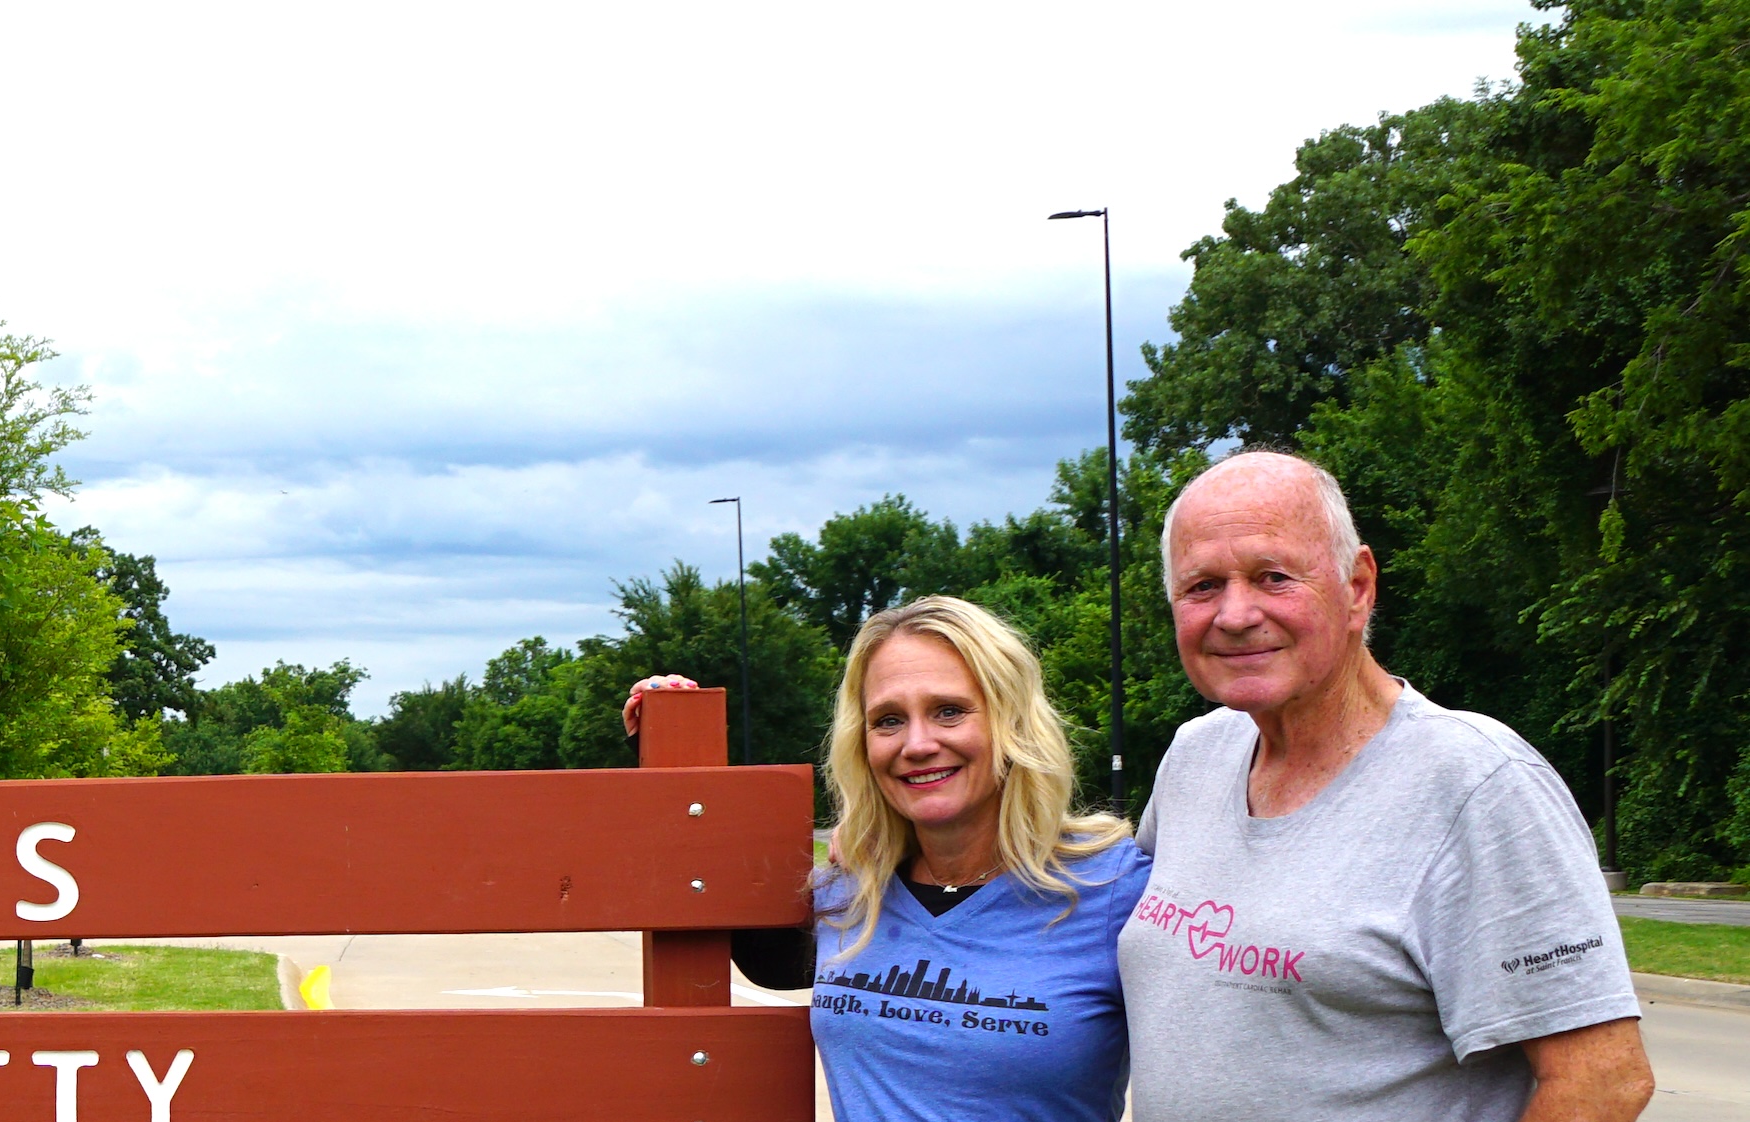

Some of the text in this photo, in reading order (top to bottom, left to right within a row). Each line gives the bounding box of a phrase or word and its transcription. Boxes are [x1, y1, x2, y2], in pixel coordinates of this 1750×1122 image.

[1218, 944, 1305, 982] WORK
[1523, 936, 1603, 966] HeartHospital
[1536, 962, 1555, 973] Saint
[811, 993, 1049, 1037] augh, Love, Serve
